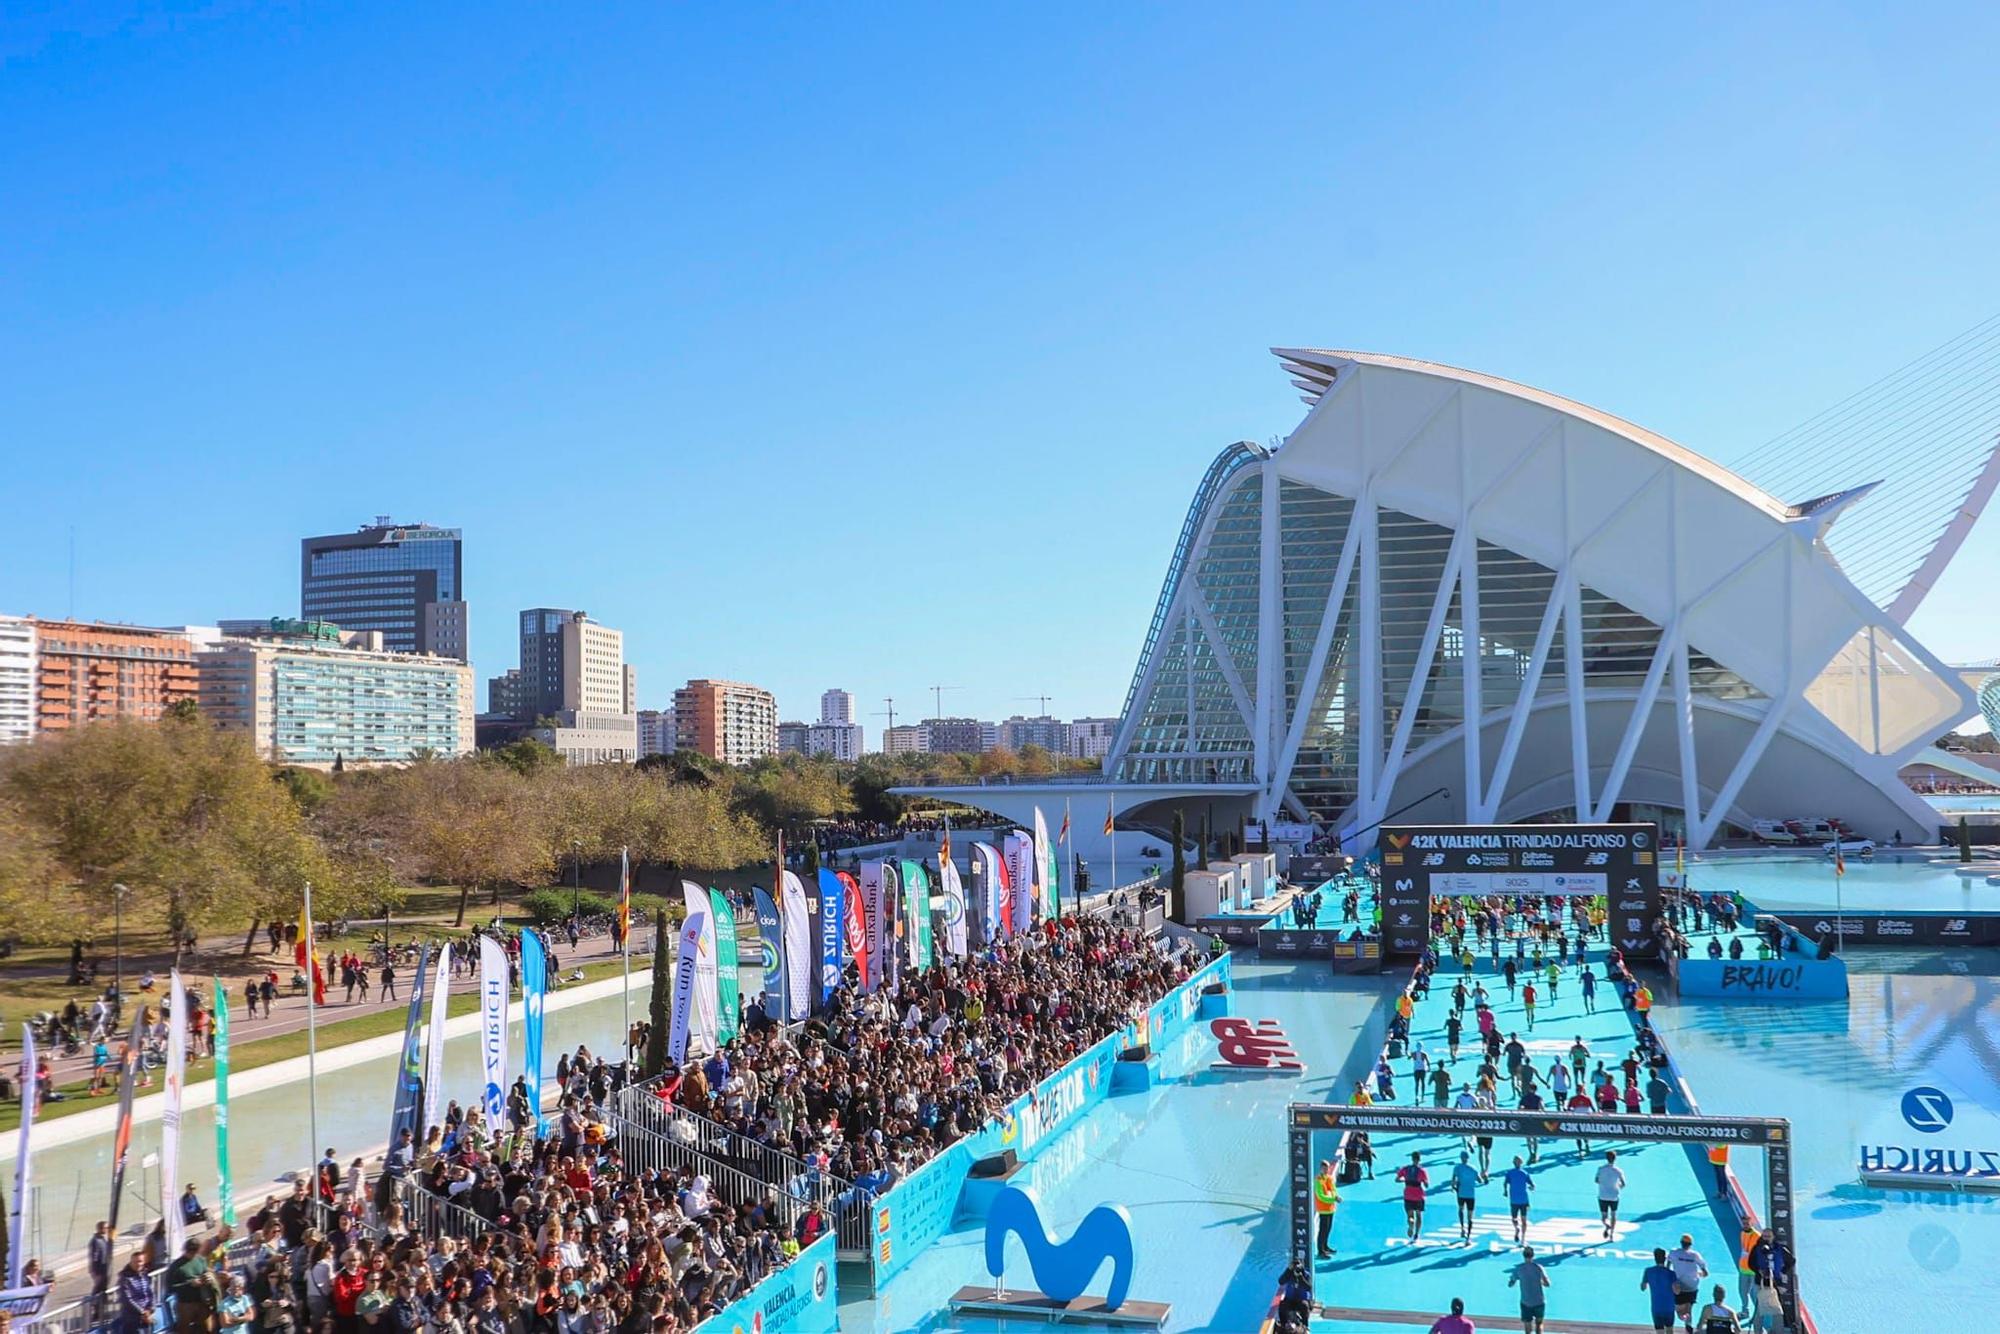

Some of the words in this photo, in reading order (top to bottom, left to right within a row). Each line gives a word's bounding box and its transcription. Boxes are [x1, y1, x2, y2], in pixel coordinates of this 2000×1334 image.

[1411, 835, 1438, 848] 42K
[1439, 835, 1501, 848] VALENCIA
[1502, 834, 1564, 848] TRINIDAD
[1563, 834, 1626, 848] ALFONSO
[866, 880, 877, 955] CaixaBank
[679, 956, 694, 990] Run
[1721, 965, 1803, 990] BRAVO!
[1339, 1116, 1357, 1126] 42K
[1358, 1117, 1399, 1127] VALENCIA
[1399, 1117, 1438, 1128] TRINIDAD
[1438, 1119, 1480, 1130] ALFONSO
[1480, 1120, 1506, 1130] 2023
[1559, 1122, 1579, 1132] 42K
[1579, 1123, 1624, 1134] VALENCIA
[1624, 1125, 1667, 1136] TRINIDAD
[1666, 1126, 1710, 1137] ALFONSO
[1710, 1127, 1737, 1138] 2023
[763, 1284, 796, 1318] VALENCIA
